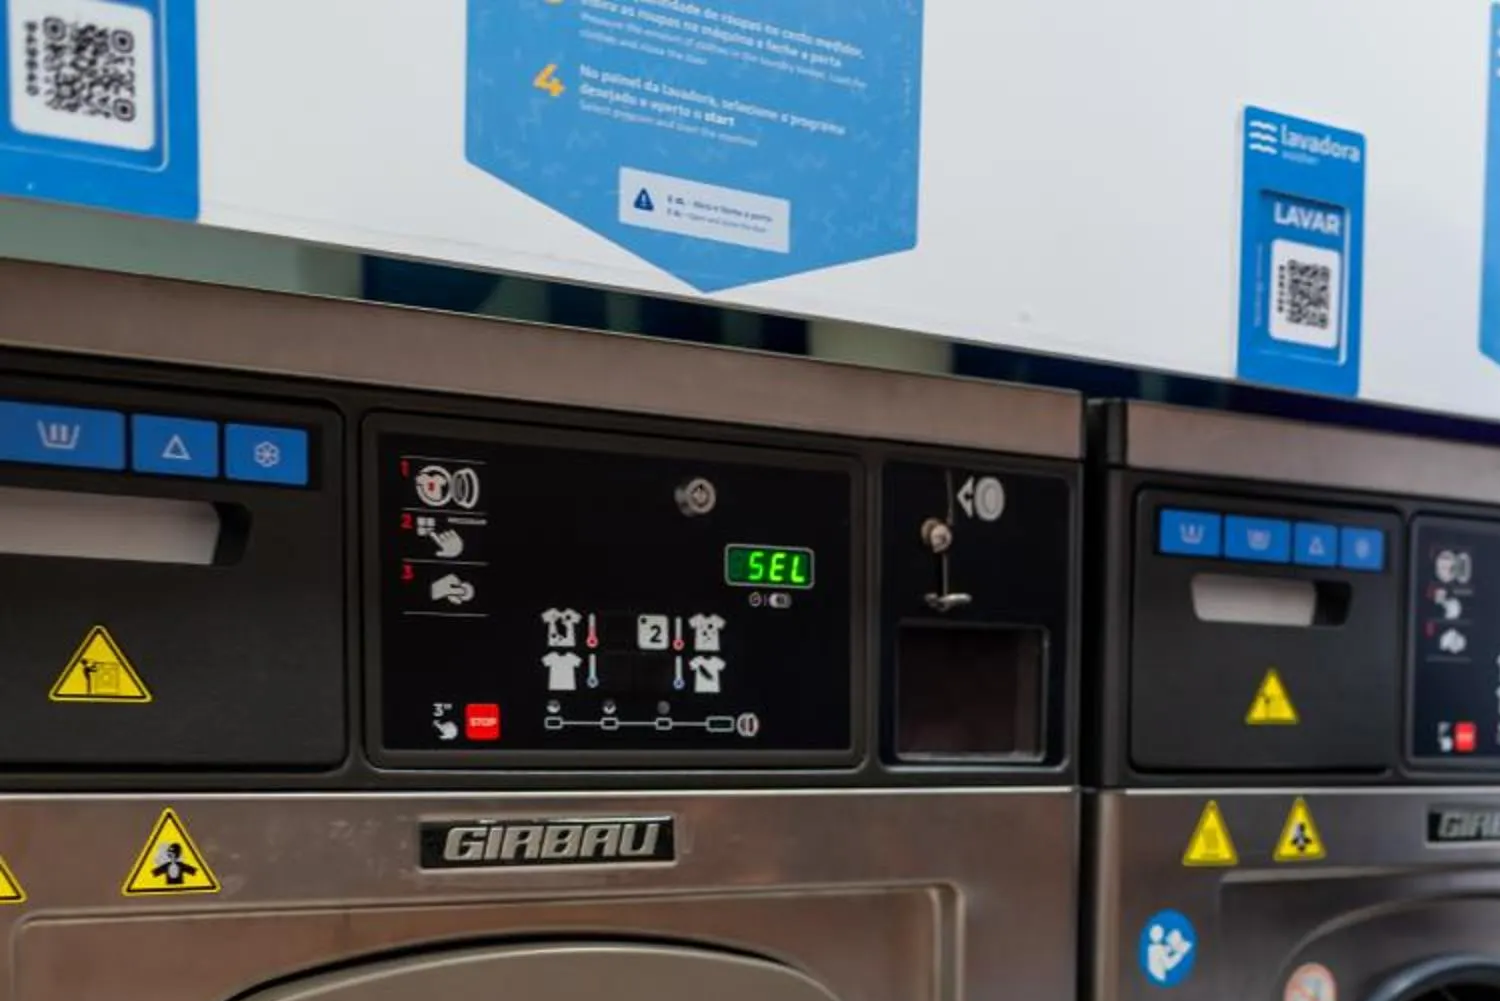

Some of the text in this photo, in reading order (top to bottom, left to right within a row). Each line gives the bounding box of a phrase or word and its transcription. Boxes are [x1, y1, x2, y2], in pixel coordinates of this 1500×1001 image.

[534, 63, 564, 97] 4
[1280, 122, 1361, 164] lavadora
[1273, 200, 1341, 237] LAVAR
[401, 512, 414, 530] 2
[401, 563, 415, 581] 3
[747, 550, 806, 584] SEL
[649, 624, 663, 643] 2
[443, 822, 661, 861] GIRBAU
